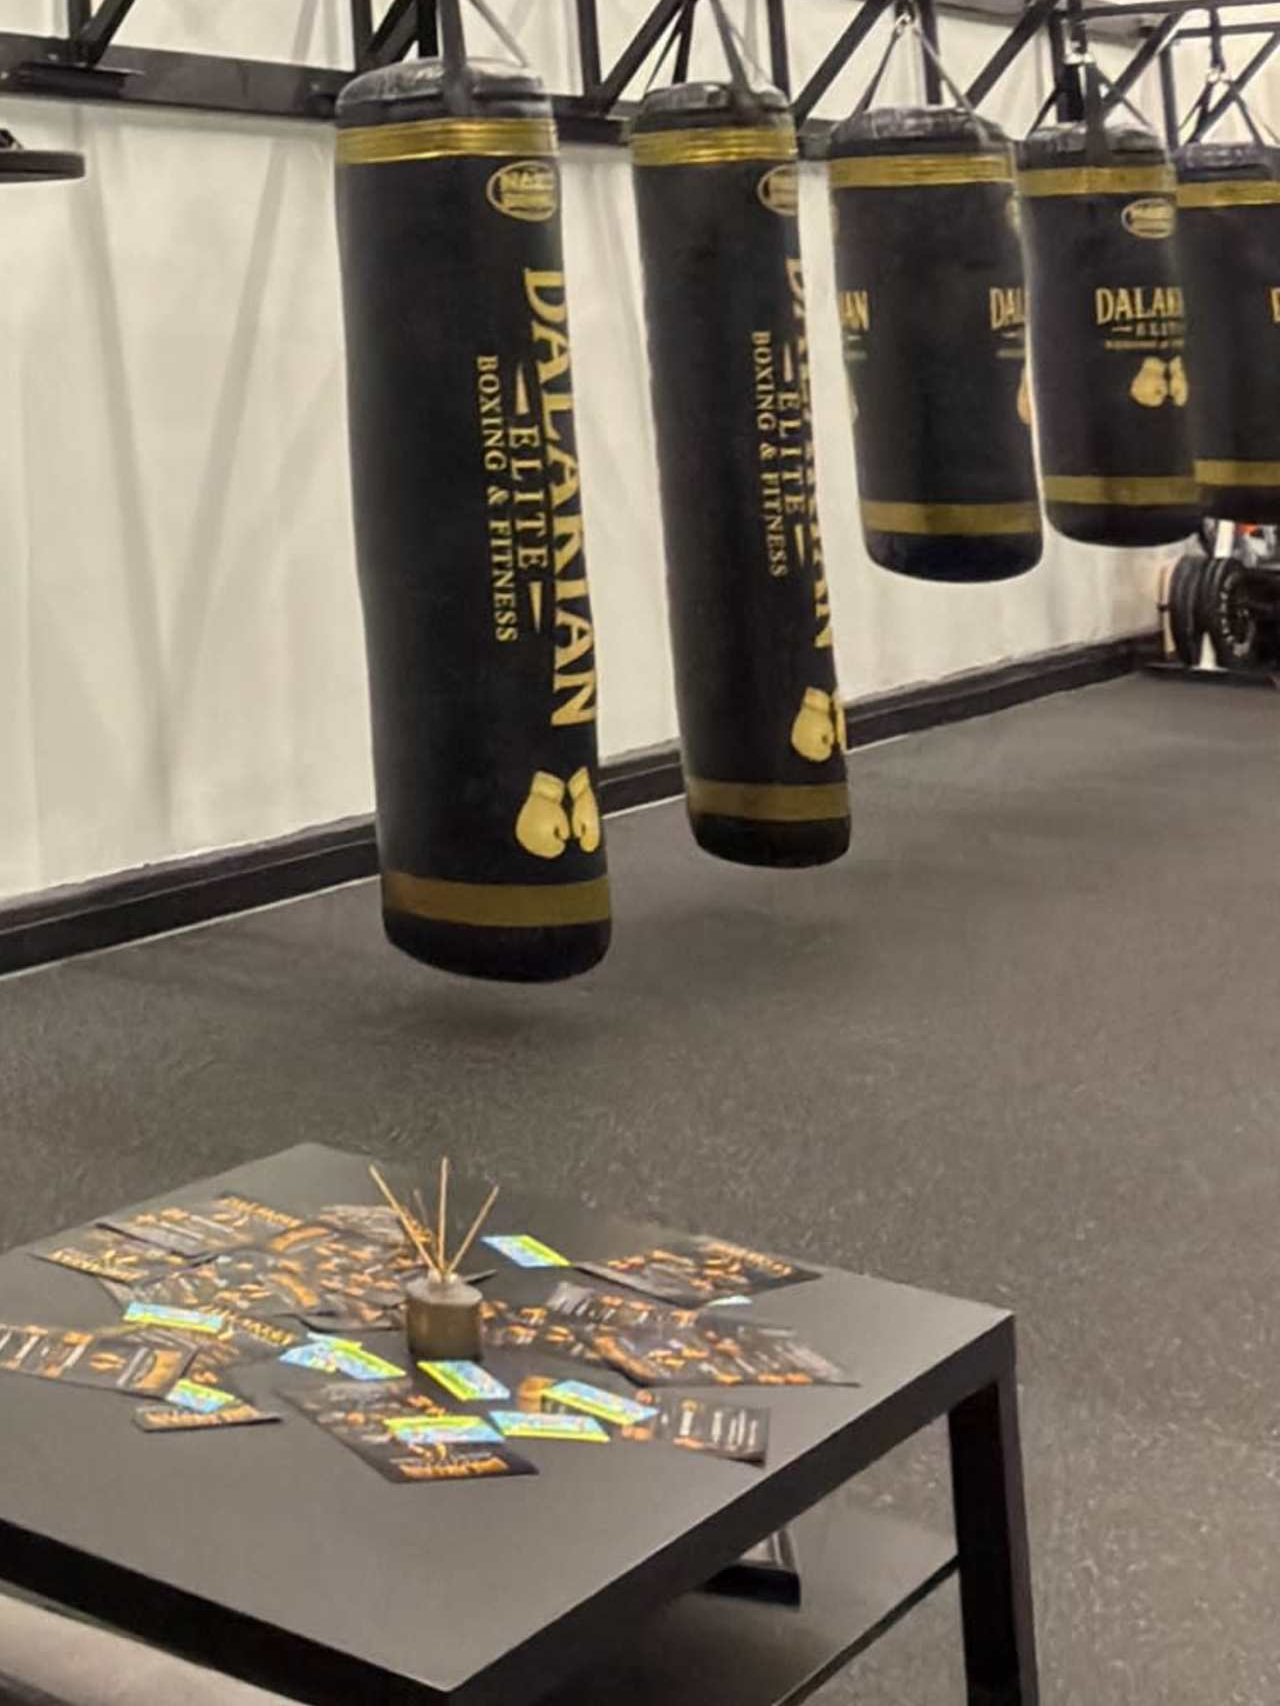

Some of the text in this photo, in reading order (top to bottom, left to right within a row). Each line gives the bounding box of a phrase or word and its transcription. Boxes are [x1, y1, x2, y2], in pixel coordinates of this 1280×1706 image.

[476, 354, 519, 642] BOXING & FITNESS
[508, 424, 547, 569] ELITE
[751, 330, 788, 578] BOXING & FITNESS
[778, 390, 807, 514] ELITE
